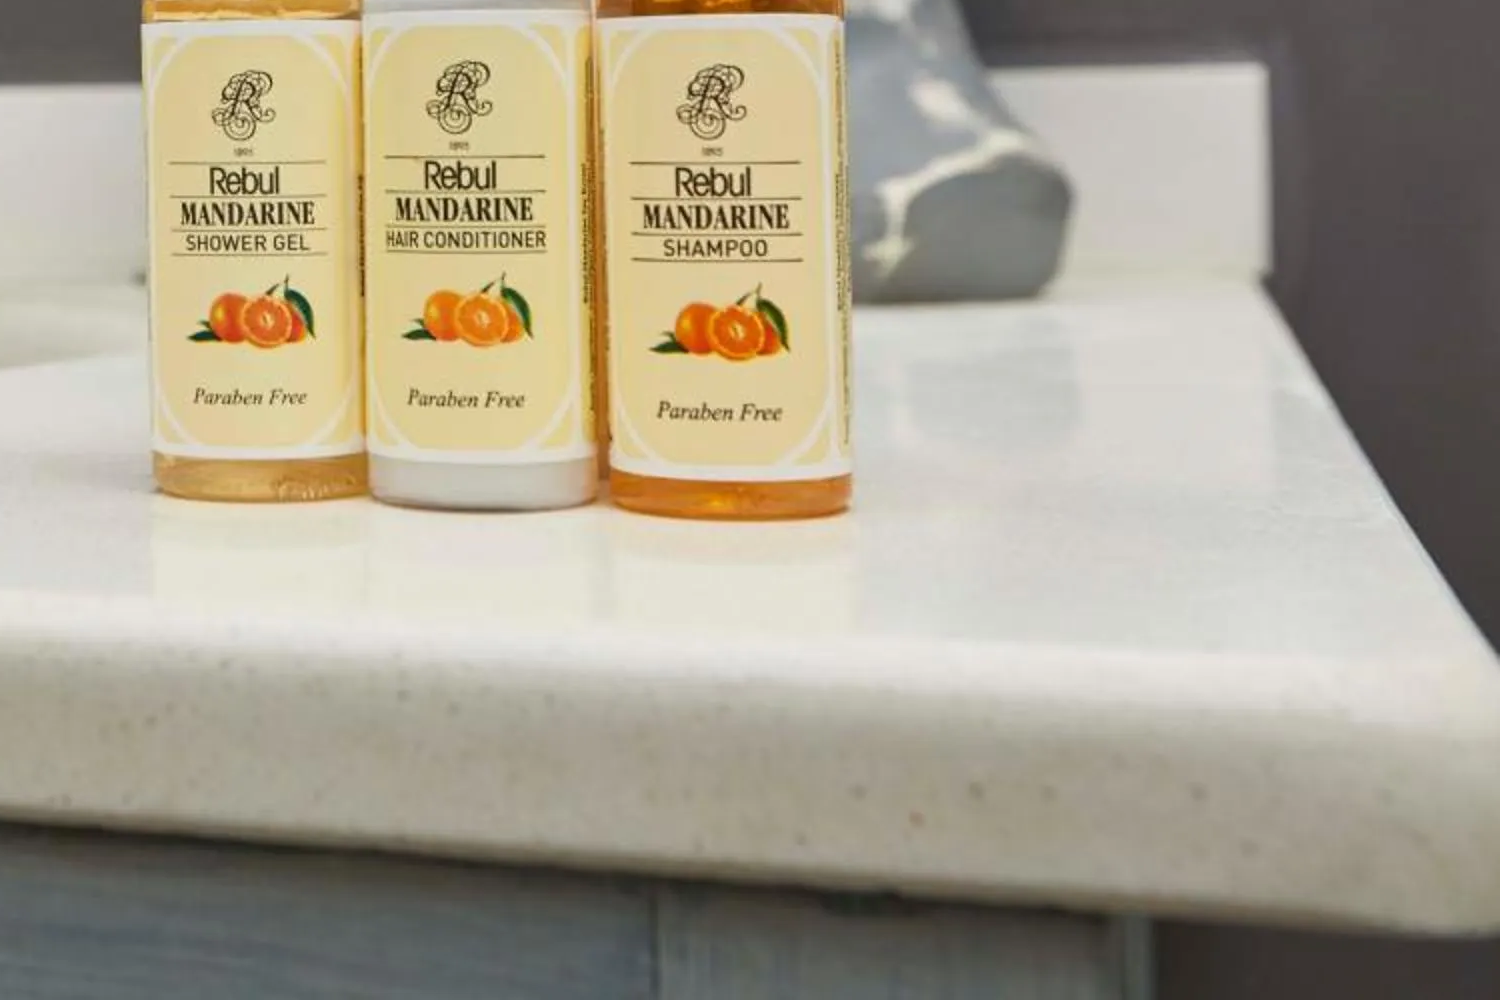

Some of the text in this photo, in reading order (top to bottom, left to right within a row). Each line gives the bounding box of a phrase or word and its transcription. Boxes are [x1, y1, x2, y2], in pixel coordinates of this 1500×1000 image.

[209, 166, 280, 195] Rebul
[425, 160, 497, 190] Rebul
[675, 166, 752, 197] Rebul
[181, 201, 315, 226] MANDARINE
[396, 197, 533, 222] MANDARINE
[643, 204, 790, 230] MANDARINE
[186, 234, 310, 251] SHOWER GEL
[386, 230, 546, 248] HAIR CONDITIONER
[663, 239, 768, 257] SHAMPOO
[193, 387, 308, 405] Paraben Free
[407, 388, 525, 408] Paraben Free
[657, 400, 783, 421] Paraben Free
